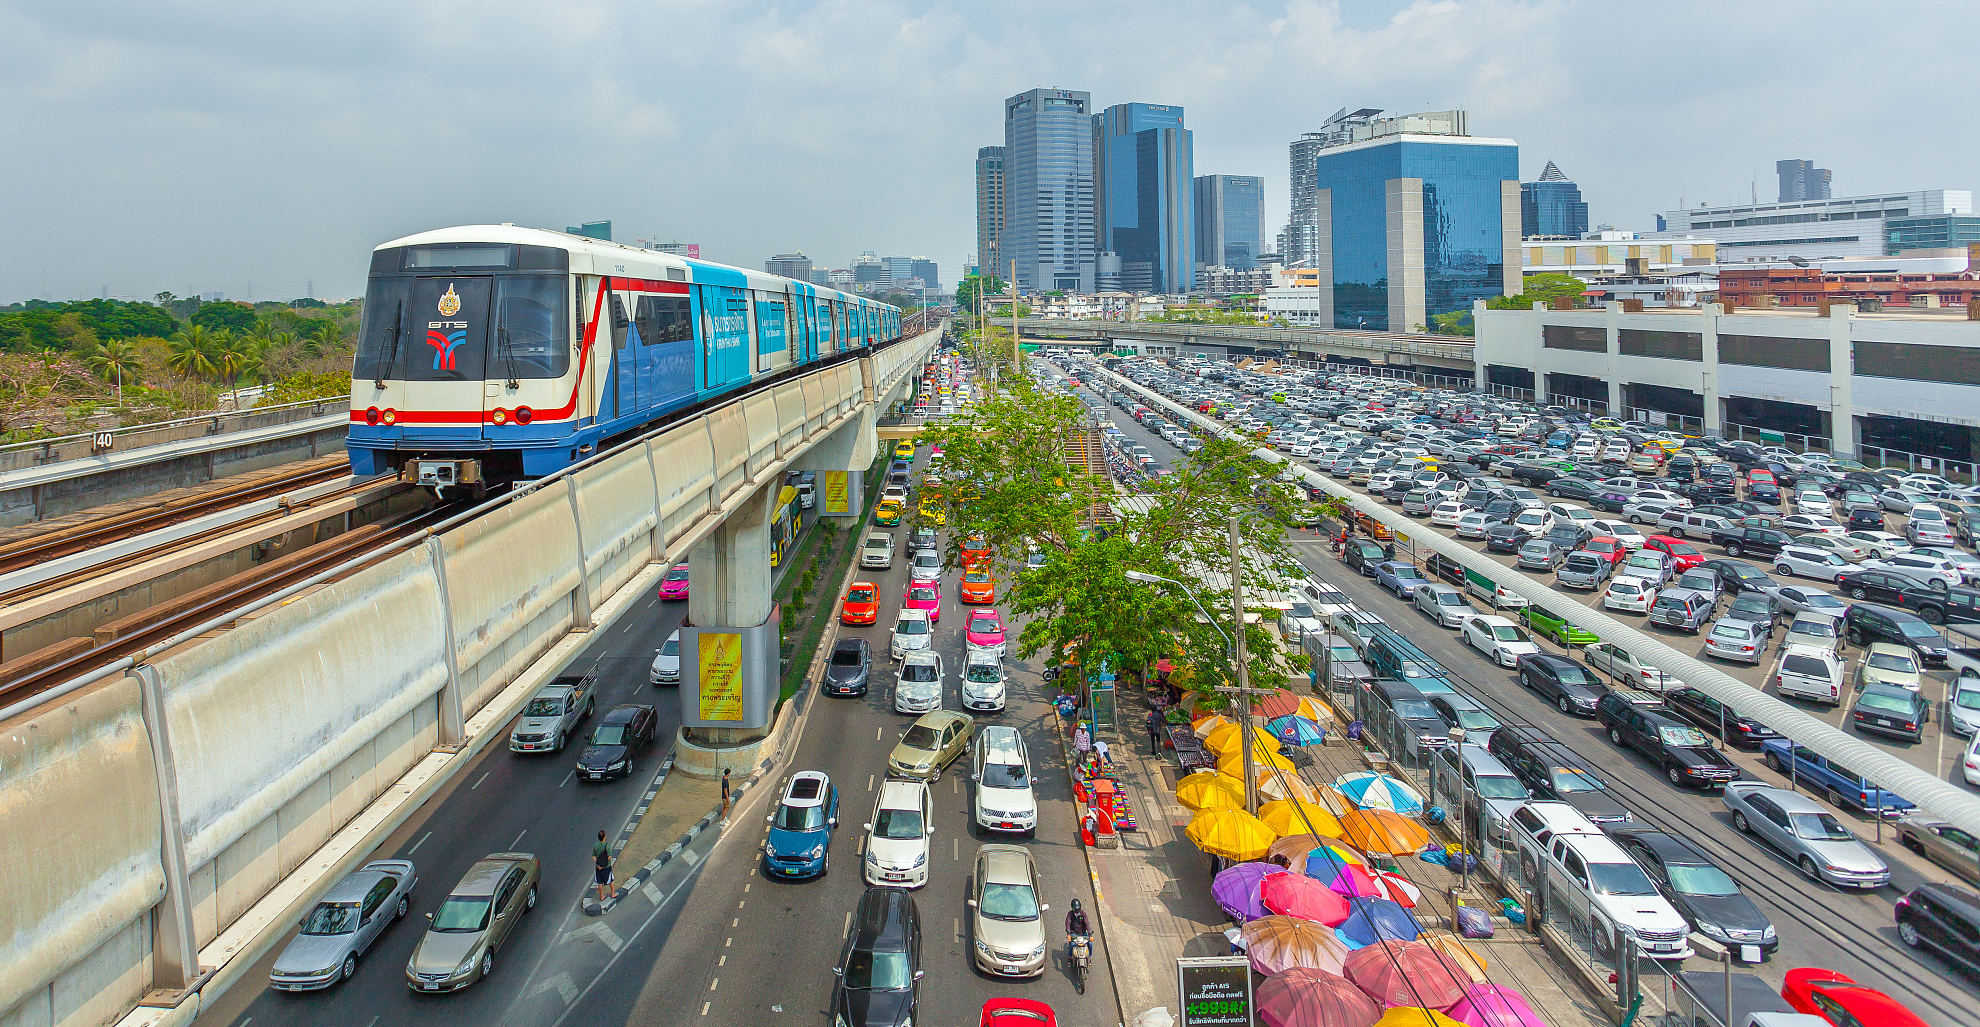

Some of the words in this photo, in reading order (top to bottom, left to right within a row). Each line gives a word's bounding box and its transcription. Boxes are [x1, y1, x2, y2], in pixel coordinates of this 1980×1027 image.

[614, 265, 625, 273] 1140
[428, 320, 468, 329] BTS
[96, 433, 112, 448] 40
